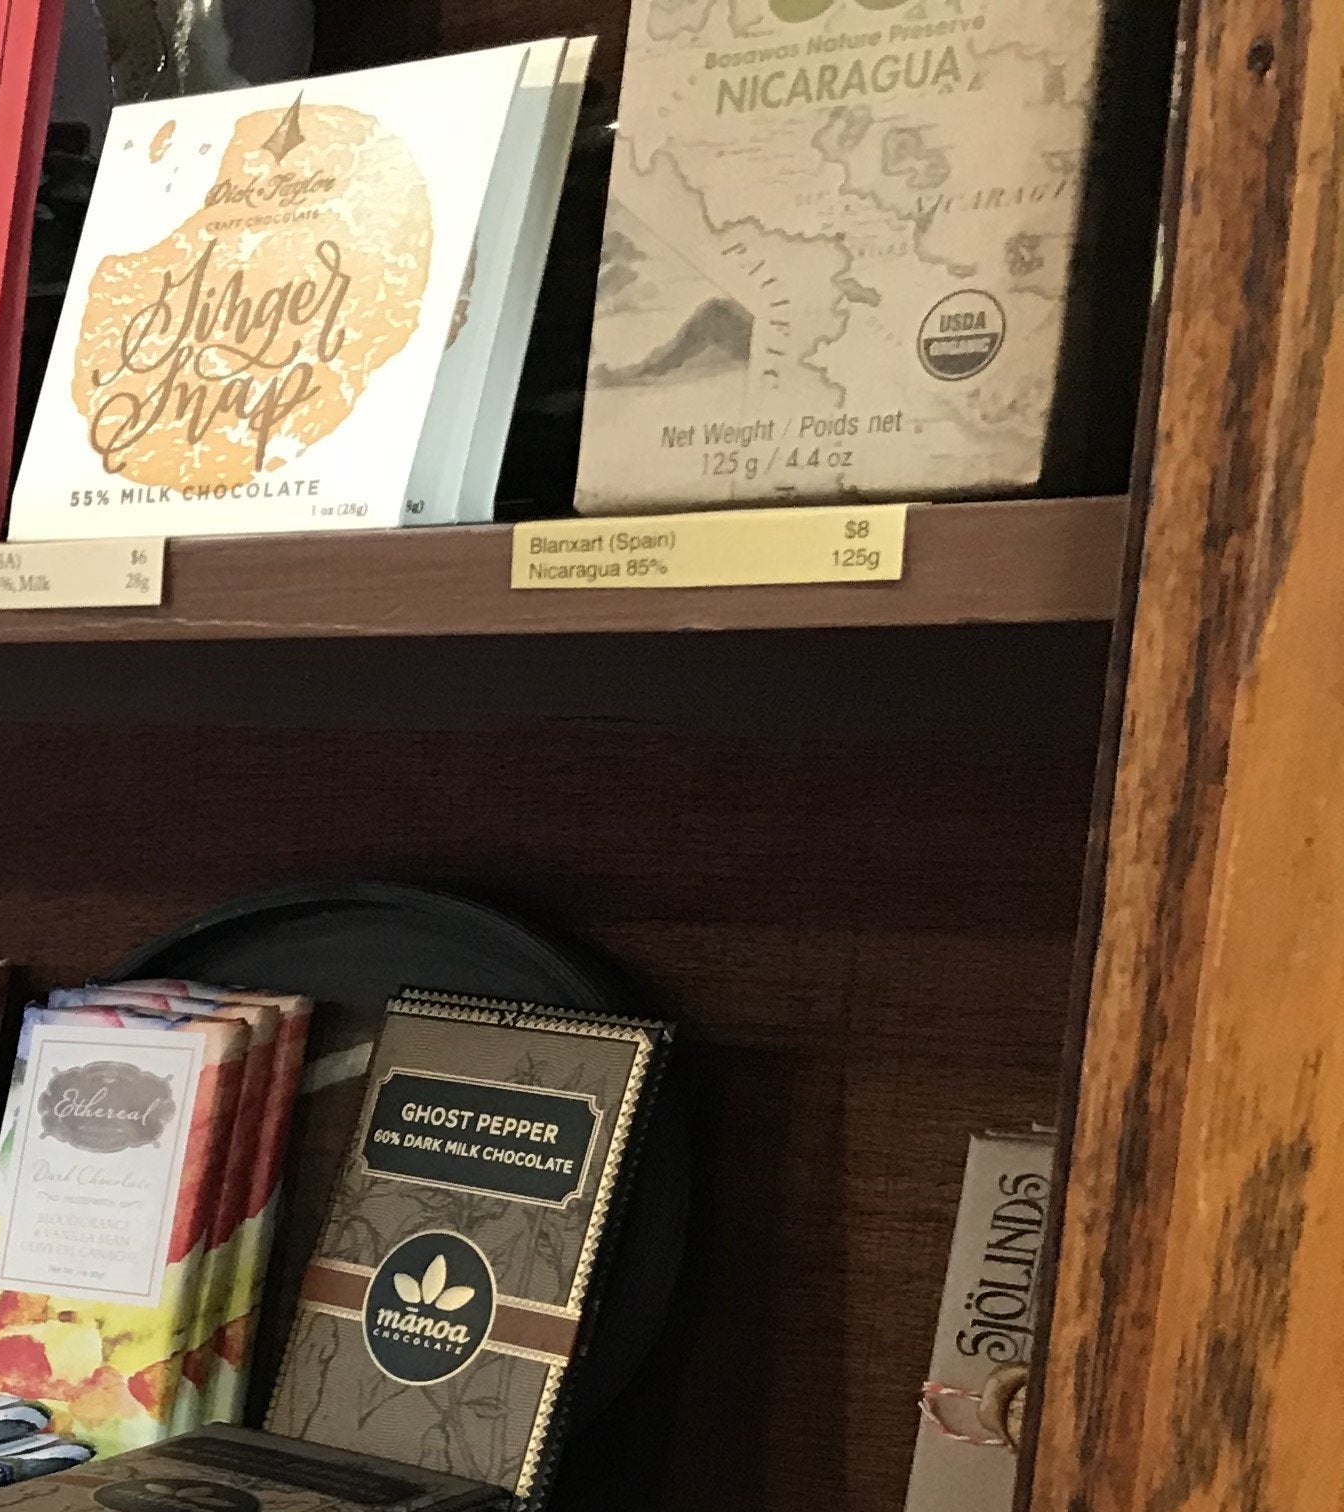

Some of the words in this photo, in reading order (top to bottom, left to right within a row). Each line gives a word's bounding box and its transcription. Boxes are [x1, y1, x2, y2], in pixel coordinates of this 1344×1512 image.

[806, 31, 882, 56] Nature
[889, 15, 986, 42] Preserve
[715, 46, 962, 117] NICARAGUA
[939, 311, 987, 332] USDA
[69, 488, 111, 508] 55%
[120, 485, 172, 505] MILK
[182, 478, 321, 502] CHOCOLATE
[529, 534, 603, 554] Blanxart
[609, 529, 677, 555] (Spain)
[844, 519, 870, 542] $8
[529, 560, 621, 582] Nicaragua
[626, 557, 669, 577] 85%
[831, 547, 881, 571] 125g
[53, 1086, 161, 1127] Ethereal
[400, 1101, 474, 1131] GHOST
[476, 1112, 560, 1145] PEPPER
[373, 1128, 401, 1146] 60%
[403, 1133, 442, 1154] DARK
[444, 1139, 479, 1161] MILK
[482, 1145, 575, 1176] CHOCOLATE
[372, 1327, 464, 1356] CHOCOLATE
